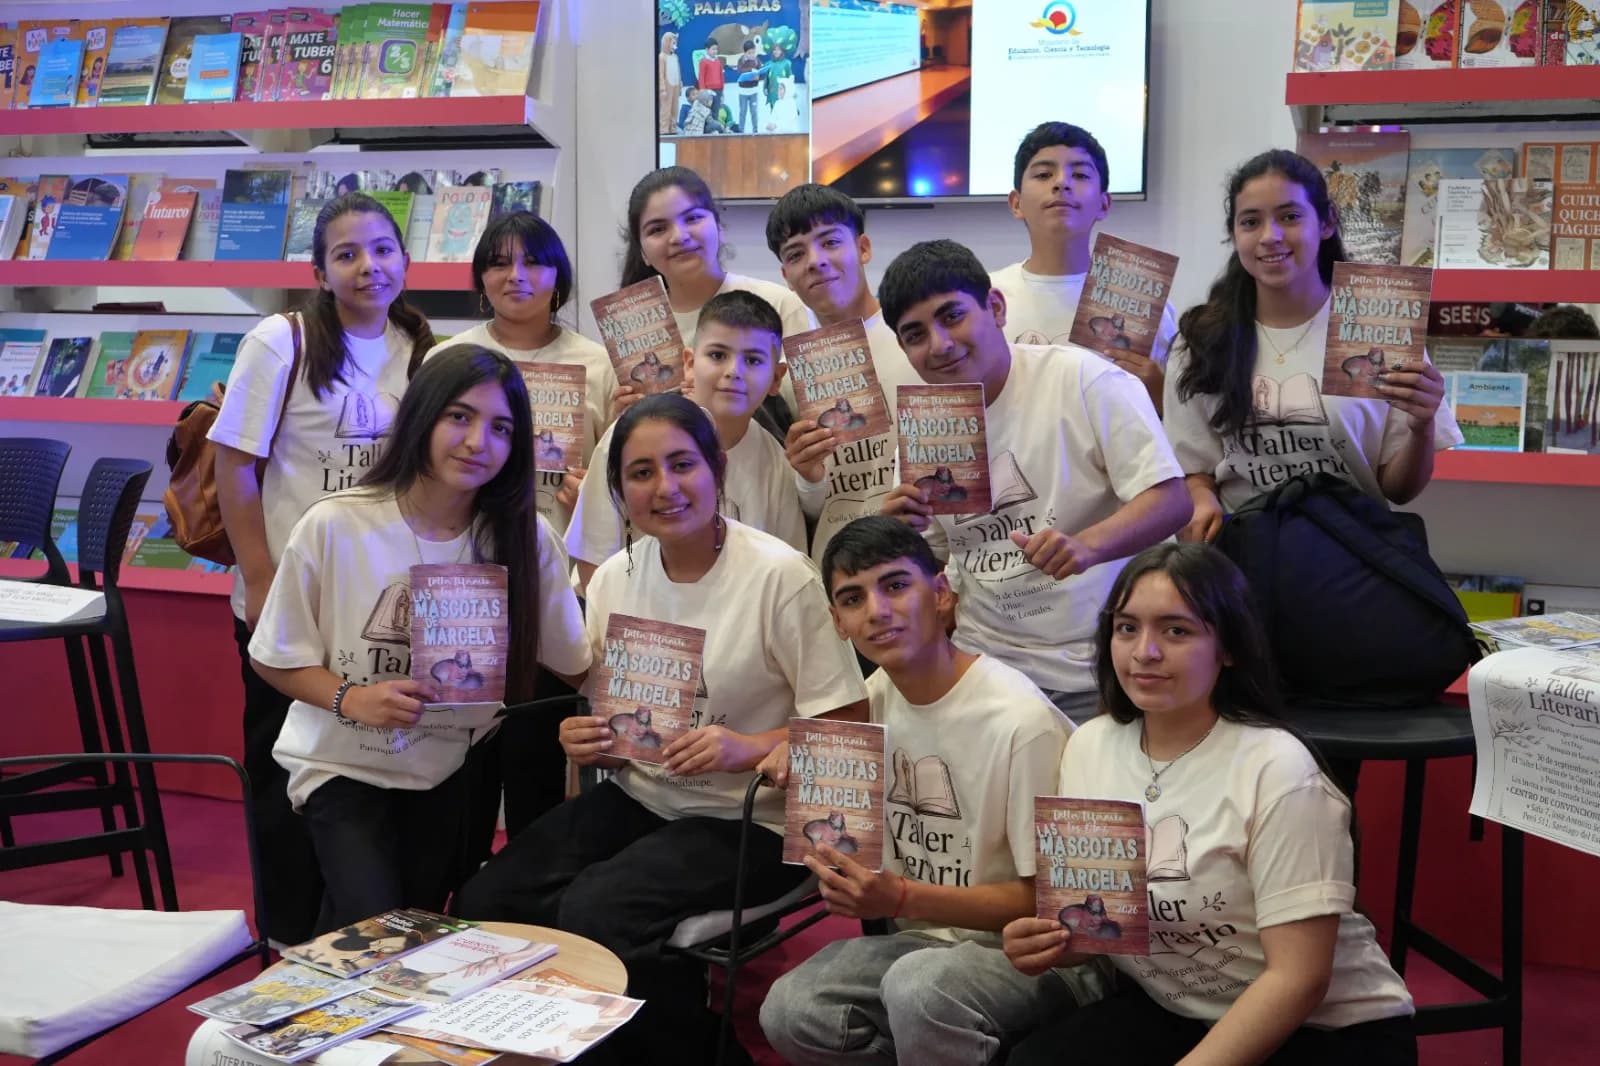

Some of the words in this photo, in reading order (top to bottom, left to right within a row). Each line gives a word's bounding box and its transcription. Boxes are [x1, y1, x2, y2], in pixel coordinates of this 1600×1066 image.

[393, 9, 420, 18] Hacer
[694, 0, 781, 16] PALABRAS
[290, 32, 324, 44] MATE
[294, 45, 335, 58] TUBER
[320, 59, 332, 74] 6
[1090, 260, 1164, 299] MASCOTAS
[1091, 286, 1152, 319] MARCELA
[1334, 296, 1422, 320] MASCOTAS
[603, 304, 669, 340] MASCOTAS
[1338, 323, 1413, 346] MARCELA
[615, 327, 673, 359] MARCELA
[793, 347, 867, 382] MASCOTAS
[530, 390, 580, 406] SCOTAS
[804, 373, 869, 403] MARCELA
[1469, 383, 1511, 391] Ambiente
[534, 411, 574, 428] RCELA
[900, 416, 979, 437] MASCOTAS
[907, 443, 977, 464] MARCELA
[1240, 430, 1325, 457] Taller
[967, 514, 1036, 543] Taller
[963, 548, 1029, 575] Litera
[413, 599, 501, 618] MASCOTAS
[423, 627, 497, 646] MARCELA
[605, 648, 693, 681] MASCOTAS
[608, 678, 682, 709] MARCELA
[1546, 678, 1595, 703] Taller
[791, 755, 878, 782] MASCOTAS
[798, 782, 873, 810] MARCELA
[1510, 786, 1539, 801] CENTRO
[1540, 795, 1549, 805] DE
[1039, 834, 1138, 861] MASCOTAS
[1050, 865, 1135, 893] MARCELA
